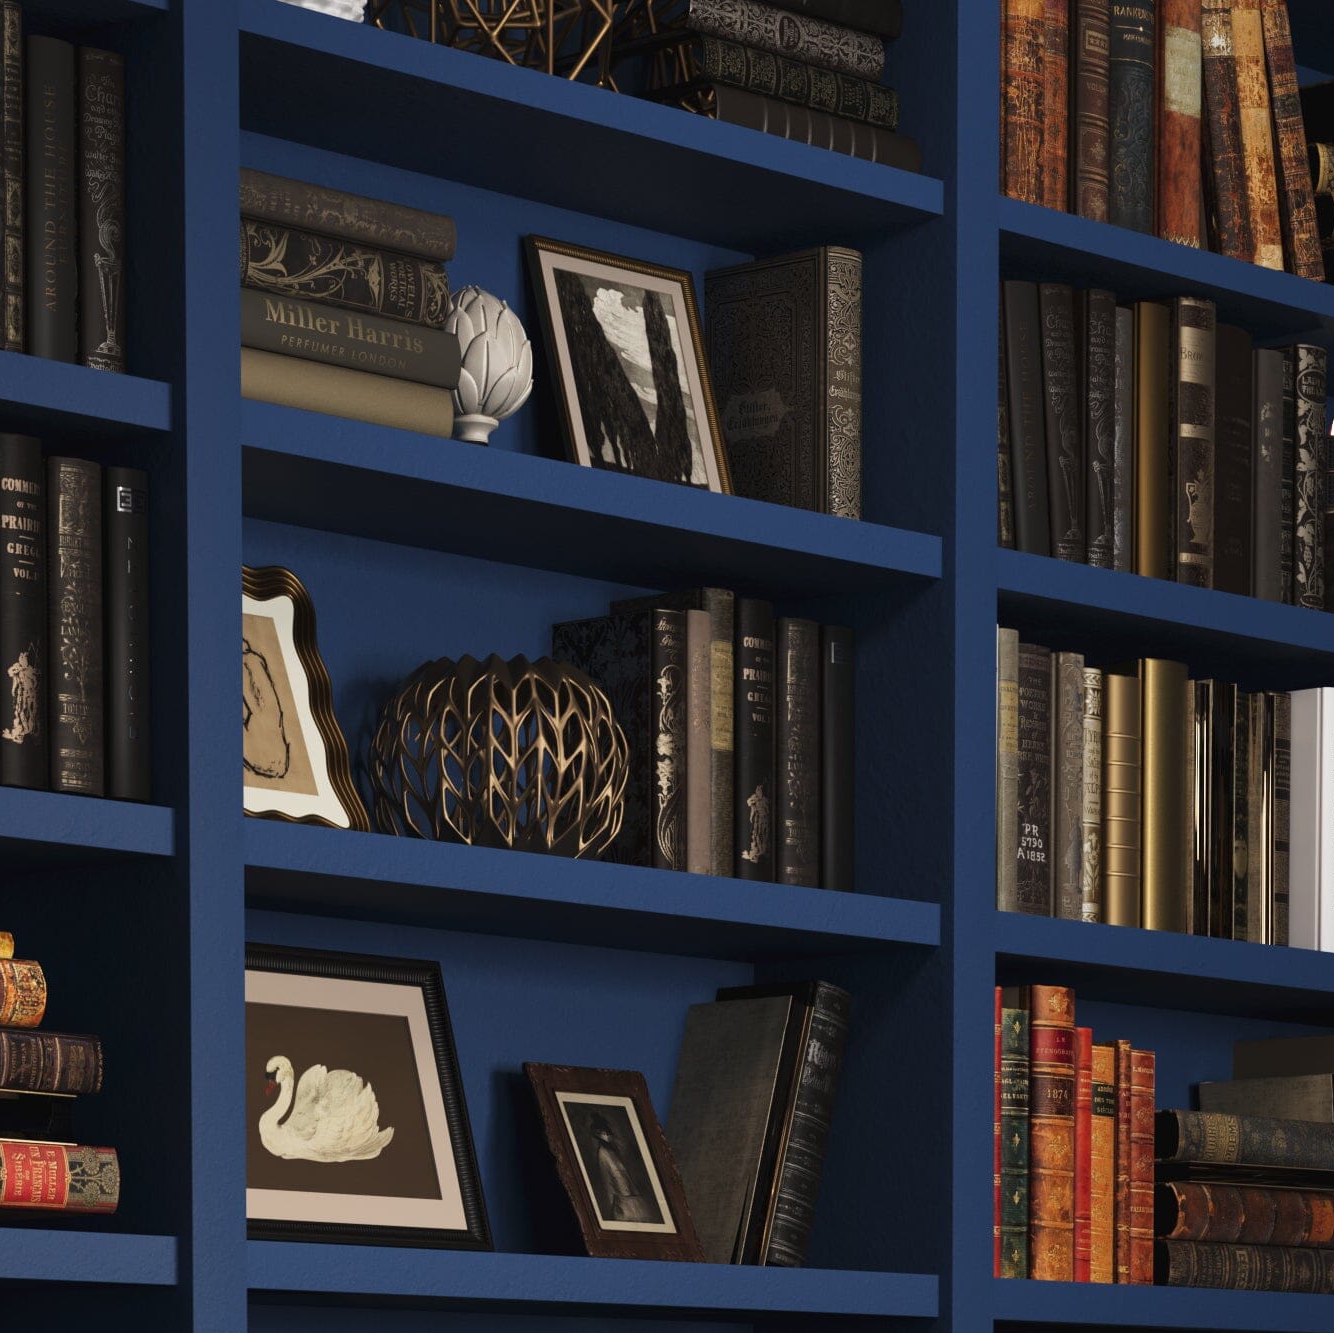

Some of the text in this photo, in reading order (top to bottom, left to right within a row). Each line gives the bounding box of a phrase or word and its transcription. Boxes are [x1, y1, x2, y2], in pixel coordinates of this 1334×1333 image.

[389, 262, 398, 302] WORKS
[266, 299, 424, 354] Miller Harris
[351, 350, 408, 370] LONDON
[1024, 823, 1040, 838] PR
[1020, 836, 1044, 850] 5790
